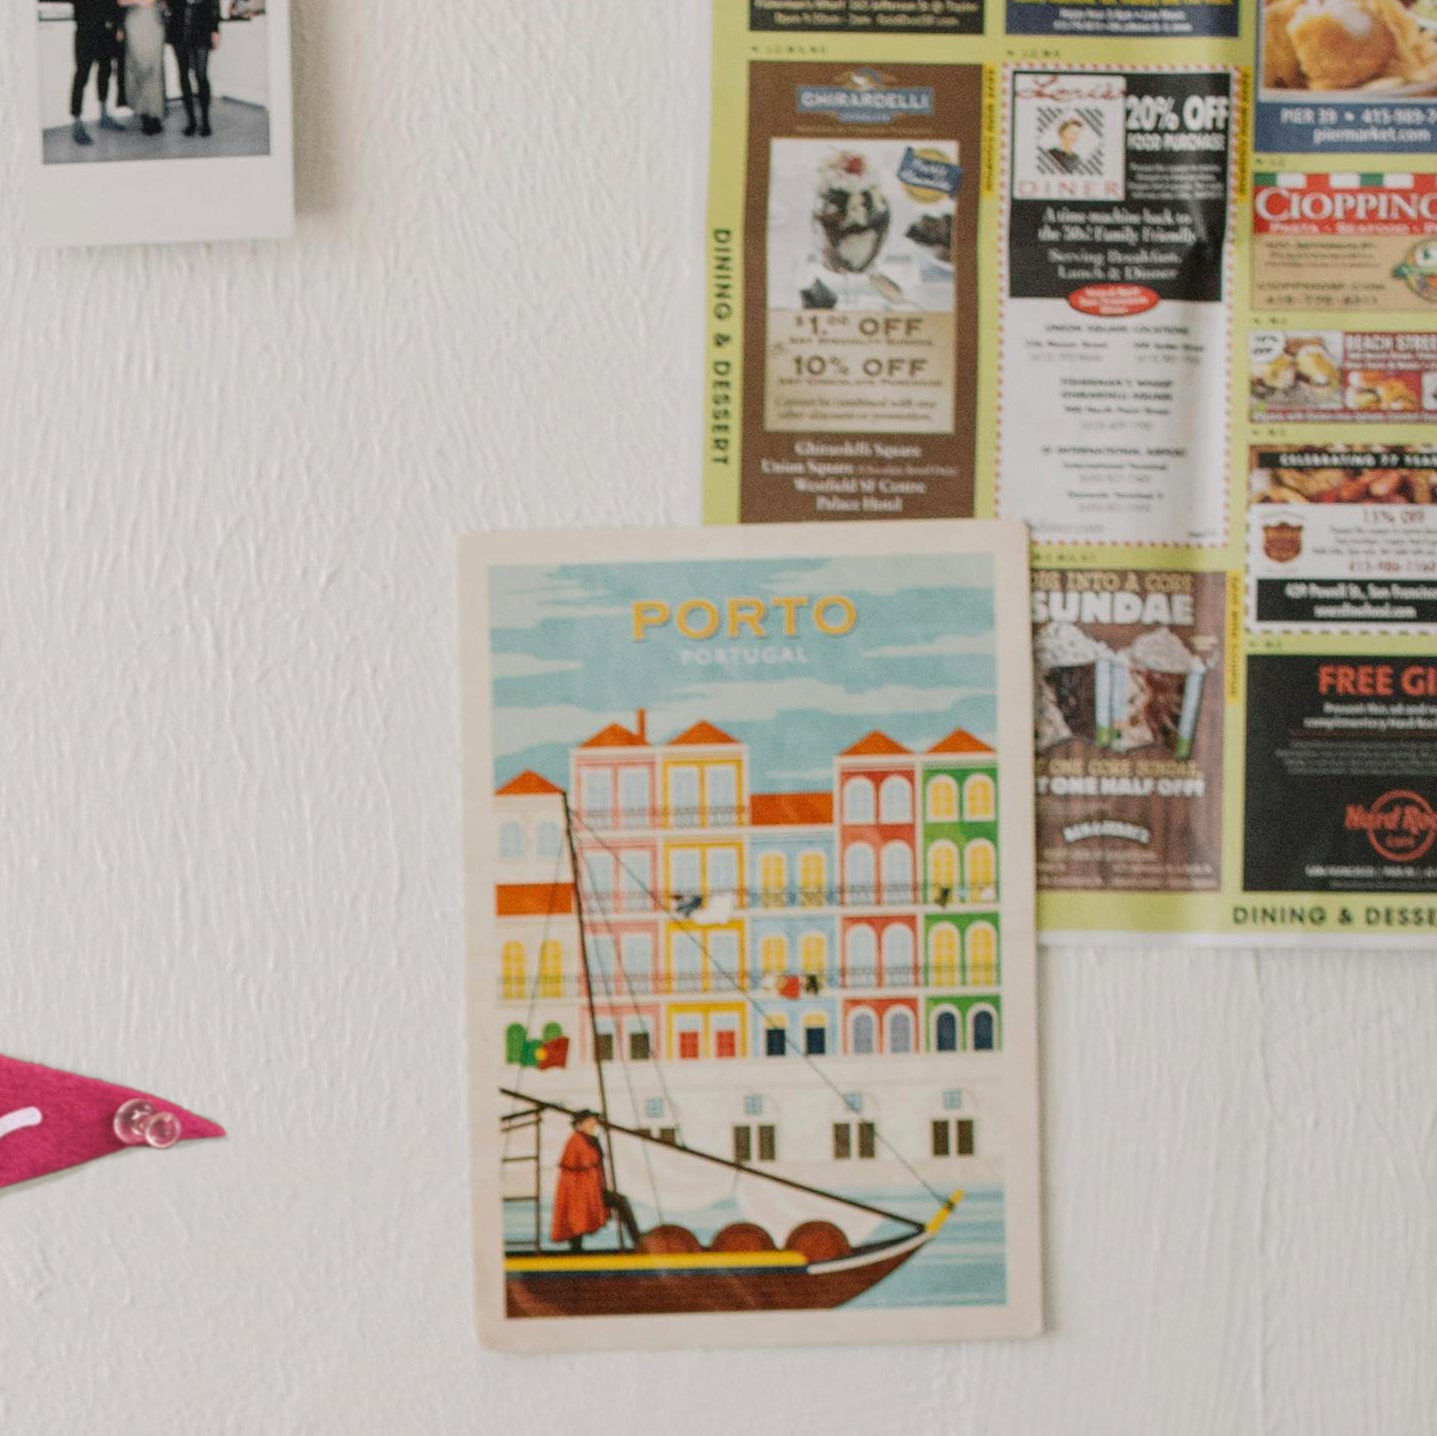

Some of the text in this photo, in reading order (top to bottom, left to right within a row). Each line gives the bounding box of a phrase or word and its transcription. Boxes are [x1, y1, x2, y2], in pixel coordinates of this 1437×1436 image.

[1126, 95, 1230, 131] 20% OFF
[858, 318, 924, 337] OFF
[712, 229, 732, 465] DINING & DESSERT
[793, 355, 929, 378] 10% OFF
[1067, 571, 1122, 591] INTO
[631, 595, 857, 641] PORTO
[1032, 593, 1195, 626] SUNDAE
[679, 646, 810, 667] PORTUGAL
[1318, 665, 1394, 697] FREE
[1050, 777, 1098, 796] ONE
[1101, 777, 1154, 796] HALF
[1233, 907, 1437, 926] DINING & DESSE
